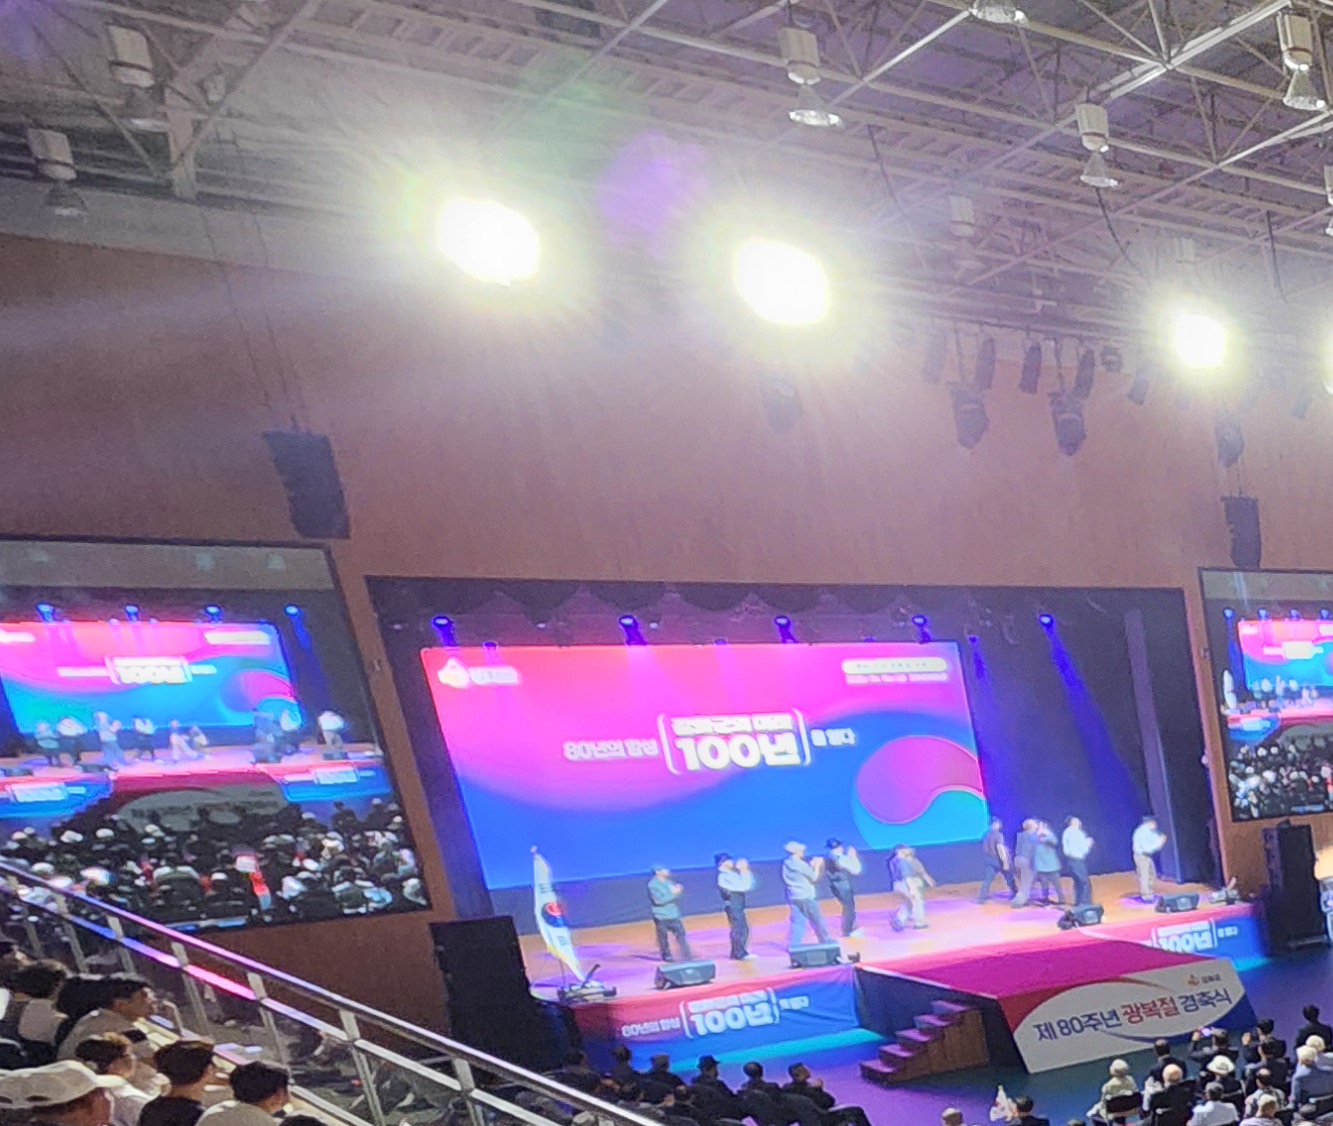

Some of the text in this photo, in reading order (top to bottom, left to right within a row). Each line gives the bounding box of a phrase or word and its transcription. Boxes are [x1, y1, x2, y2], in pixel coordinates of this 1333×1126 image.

[674, 731, 802, 771] 100년
[690, 1002, 774, 1035] 100년
[1121, 997, 1180, 1024] 광복절
[1178, 988, 1233, 1013] 경축식
